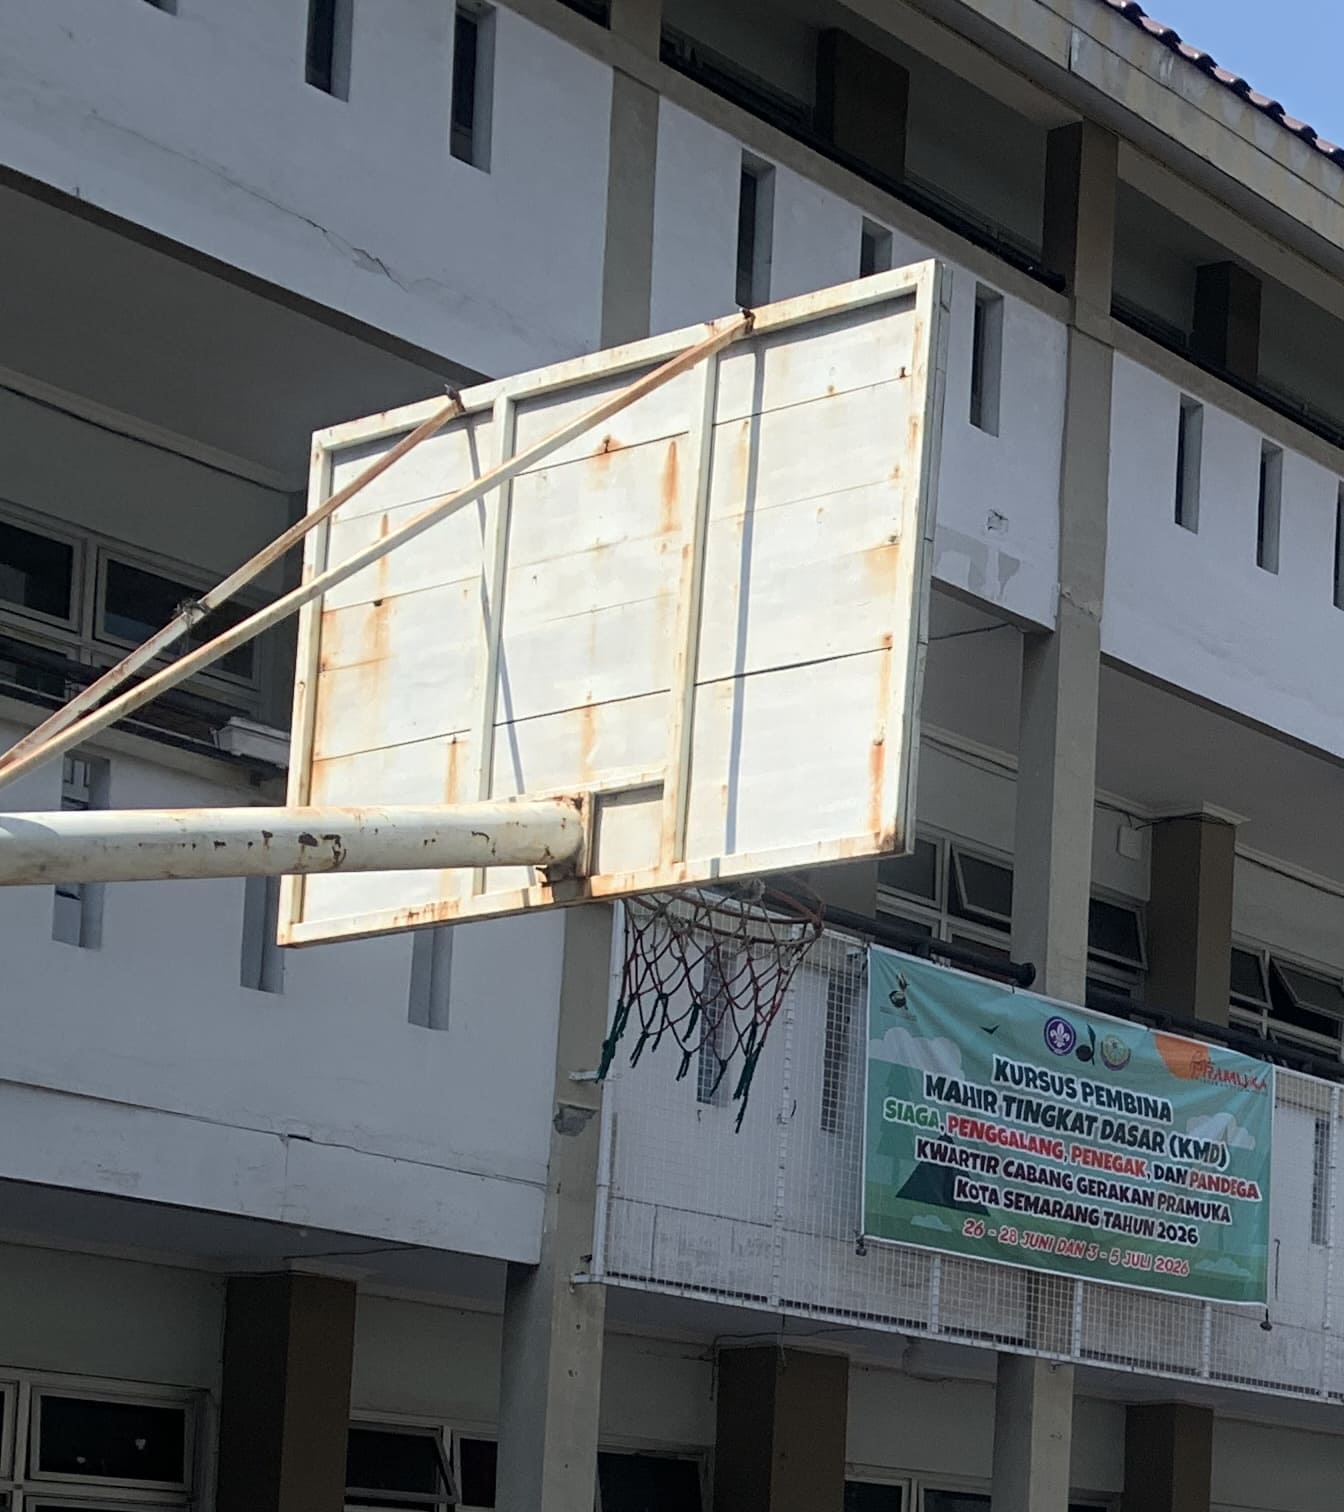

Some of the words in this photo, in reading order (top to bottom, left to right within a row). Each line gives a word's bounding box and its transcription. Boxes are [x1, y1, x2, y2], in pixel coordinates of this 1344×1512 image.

[925, 1073, 998, 1114] MAHIR
[1002, 1094, 1099, 1137] TINGKAT
[1100, 1119, 1165, 1153] DASAR
[1169, 1134, 1229, 1169] (KMD)
[994, 1056, 1078, 1100] KURSUS
[1080, 1081, 1172, 1122] PEMBINA
[884, 1099, 945, 1132] SIAGA,
[947, 1114, 1068, 1162] PENGGALANG,
[1071, 1145, 1151, 1180] PENEGAK,
[1153, 1163, 1188, 1185] DAN
[1189, 1169, 1260, 1200] PANDEGA
[916, 1138, 1000, 1175] KWARTIR
[1002, 1160, 1074, 1192] CABANG
[1076, 1176, 1155, 1208] GERAKAN
[1157, 1192, 1231, 1223] PRAMUKA
[955, 1178, 1000, 1206] KOTA
[1003, 1189, 1100, 1226] SEMARANG
[1103, 1210, 1155, 1238] TAHUN
[1157, 1221, 1199, 1245] 2026
[963, 1219, 985, 1236] 26
[999, 1226, 1018, 1244] 28
[1022, 1231, 1054, 1252] JUNI
[1056, 1239, 1085, 1258] DAN
[1086, 1243, 1098, 1260] 3
[1110, 1248, 1120, 1264] 5
[1123, 1251, 1152, 1270] JULI
[1155, 1257, 1190, 1275] 2026
